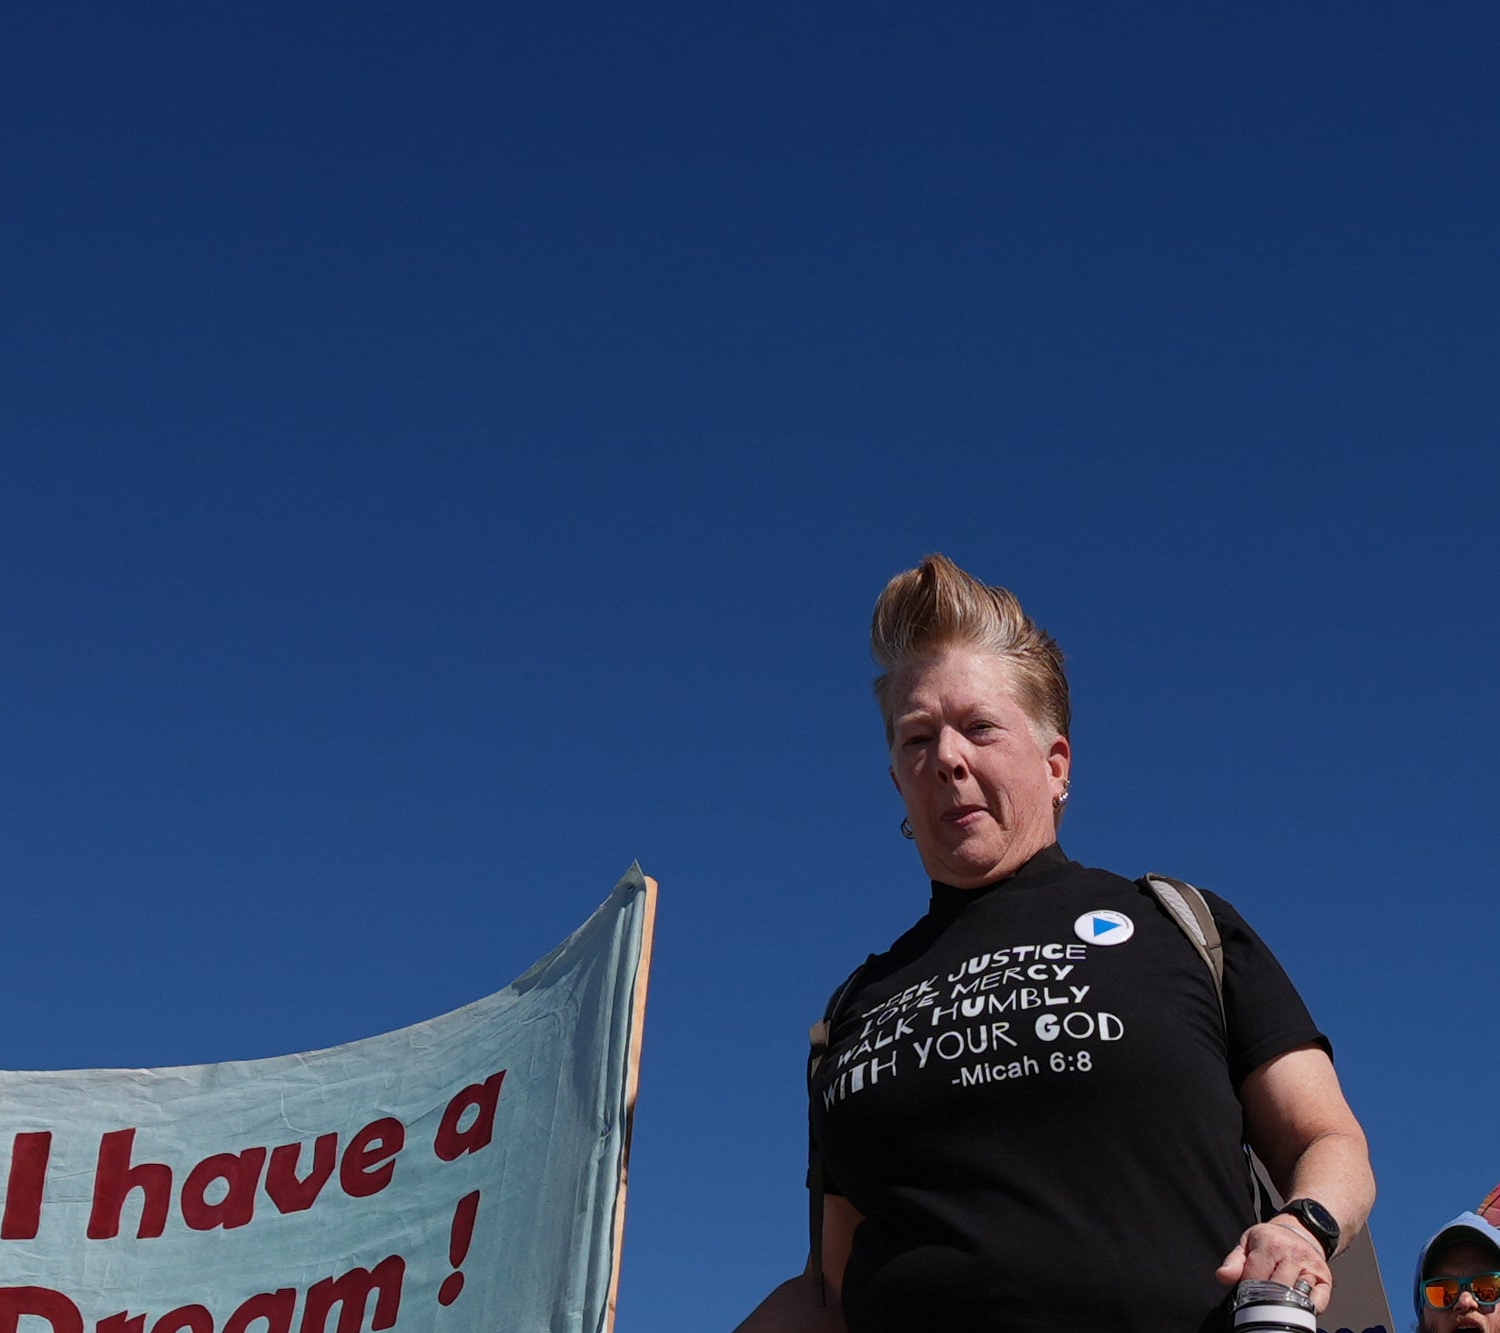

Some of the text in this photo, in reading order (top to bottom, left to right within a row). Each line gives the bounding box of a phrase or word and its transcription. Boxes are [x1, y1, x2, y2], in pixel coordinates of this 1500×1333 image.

[947, 943, 1088, 983] JUSTICE
[950, 964, 1075, 999] MERCY
[836, 985, 1091, 1069] WALK HUMBLY
[822, 1011, 1125, 1112] WITH YOUR GOD
[951, 1051, 1093, 1087] -Micah 6:8
[0, 1069, 507, 1241] I have a
